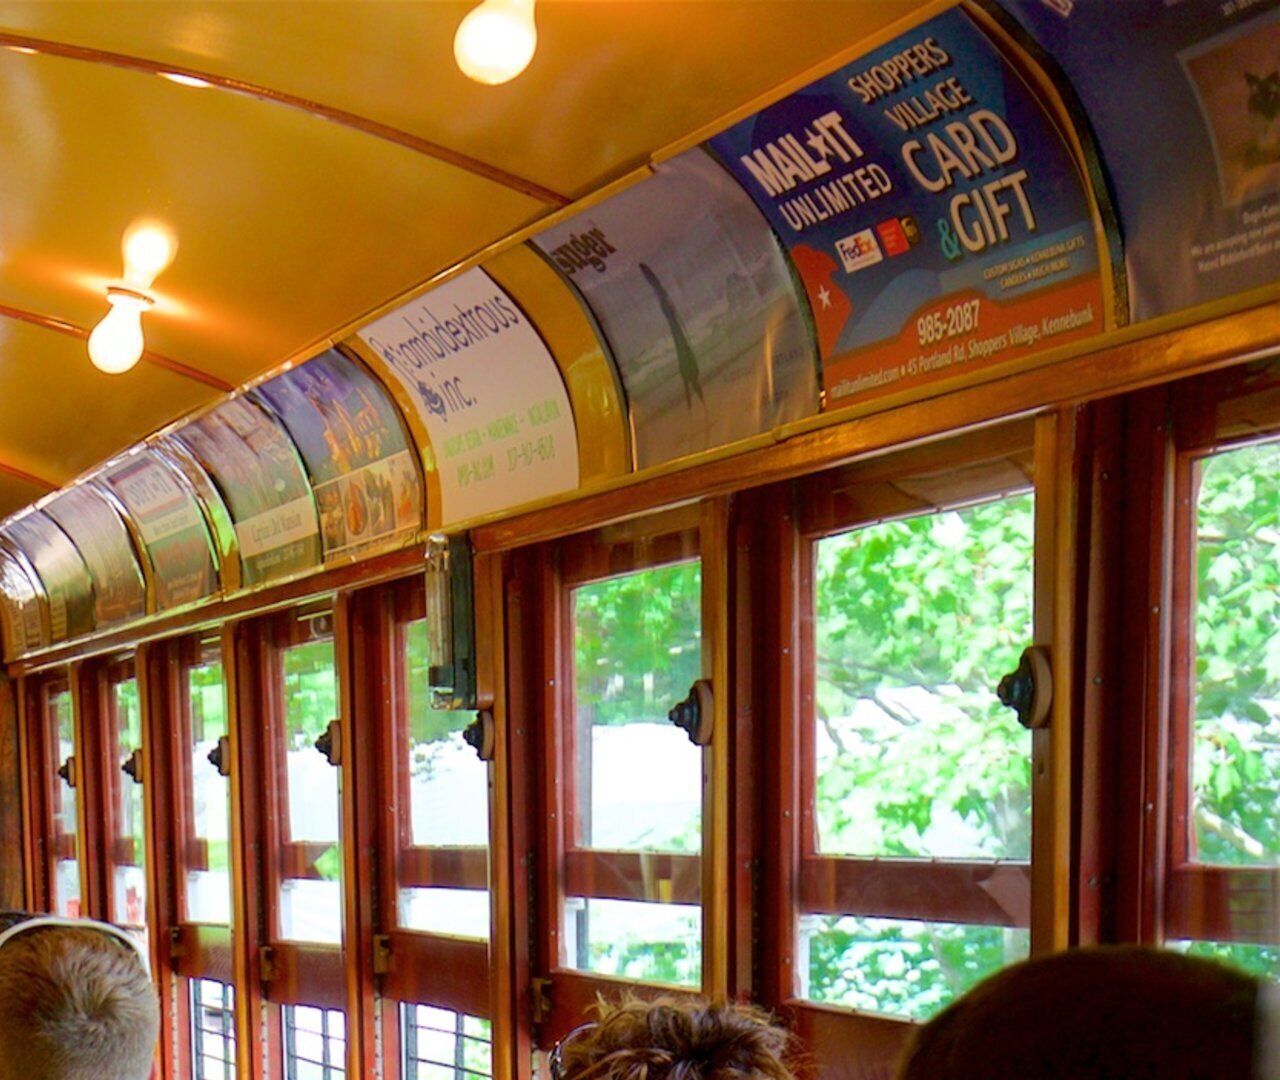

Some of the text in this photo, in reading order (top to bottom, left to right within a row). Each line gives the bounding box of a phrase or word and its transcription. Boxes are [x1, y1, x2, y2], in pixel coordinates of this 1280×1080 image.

[848, 37, 950, 104] SHOPPERS
[884, 76, 973, 132] VILLAGE
[901, 109, 1018, 193] CARD
[778, 162, 894, 232] UNLIMITED
[839, 236, 877, 262] FedEx
[906, 358, 918, 377] 45
[918, 348, 952, 373] Portland
[967, 335, 1007, 359] Shoppers
[1041, 304, 1094, 337] Kennebunk
[917, 300, 981, 346] 985-2087
